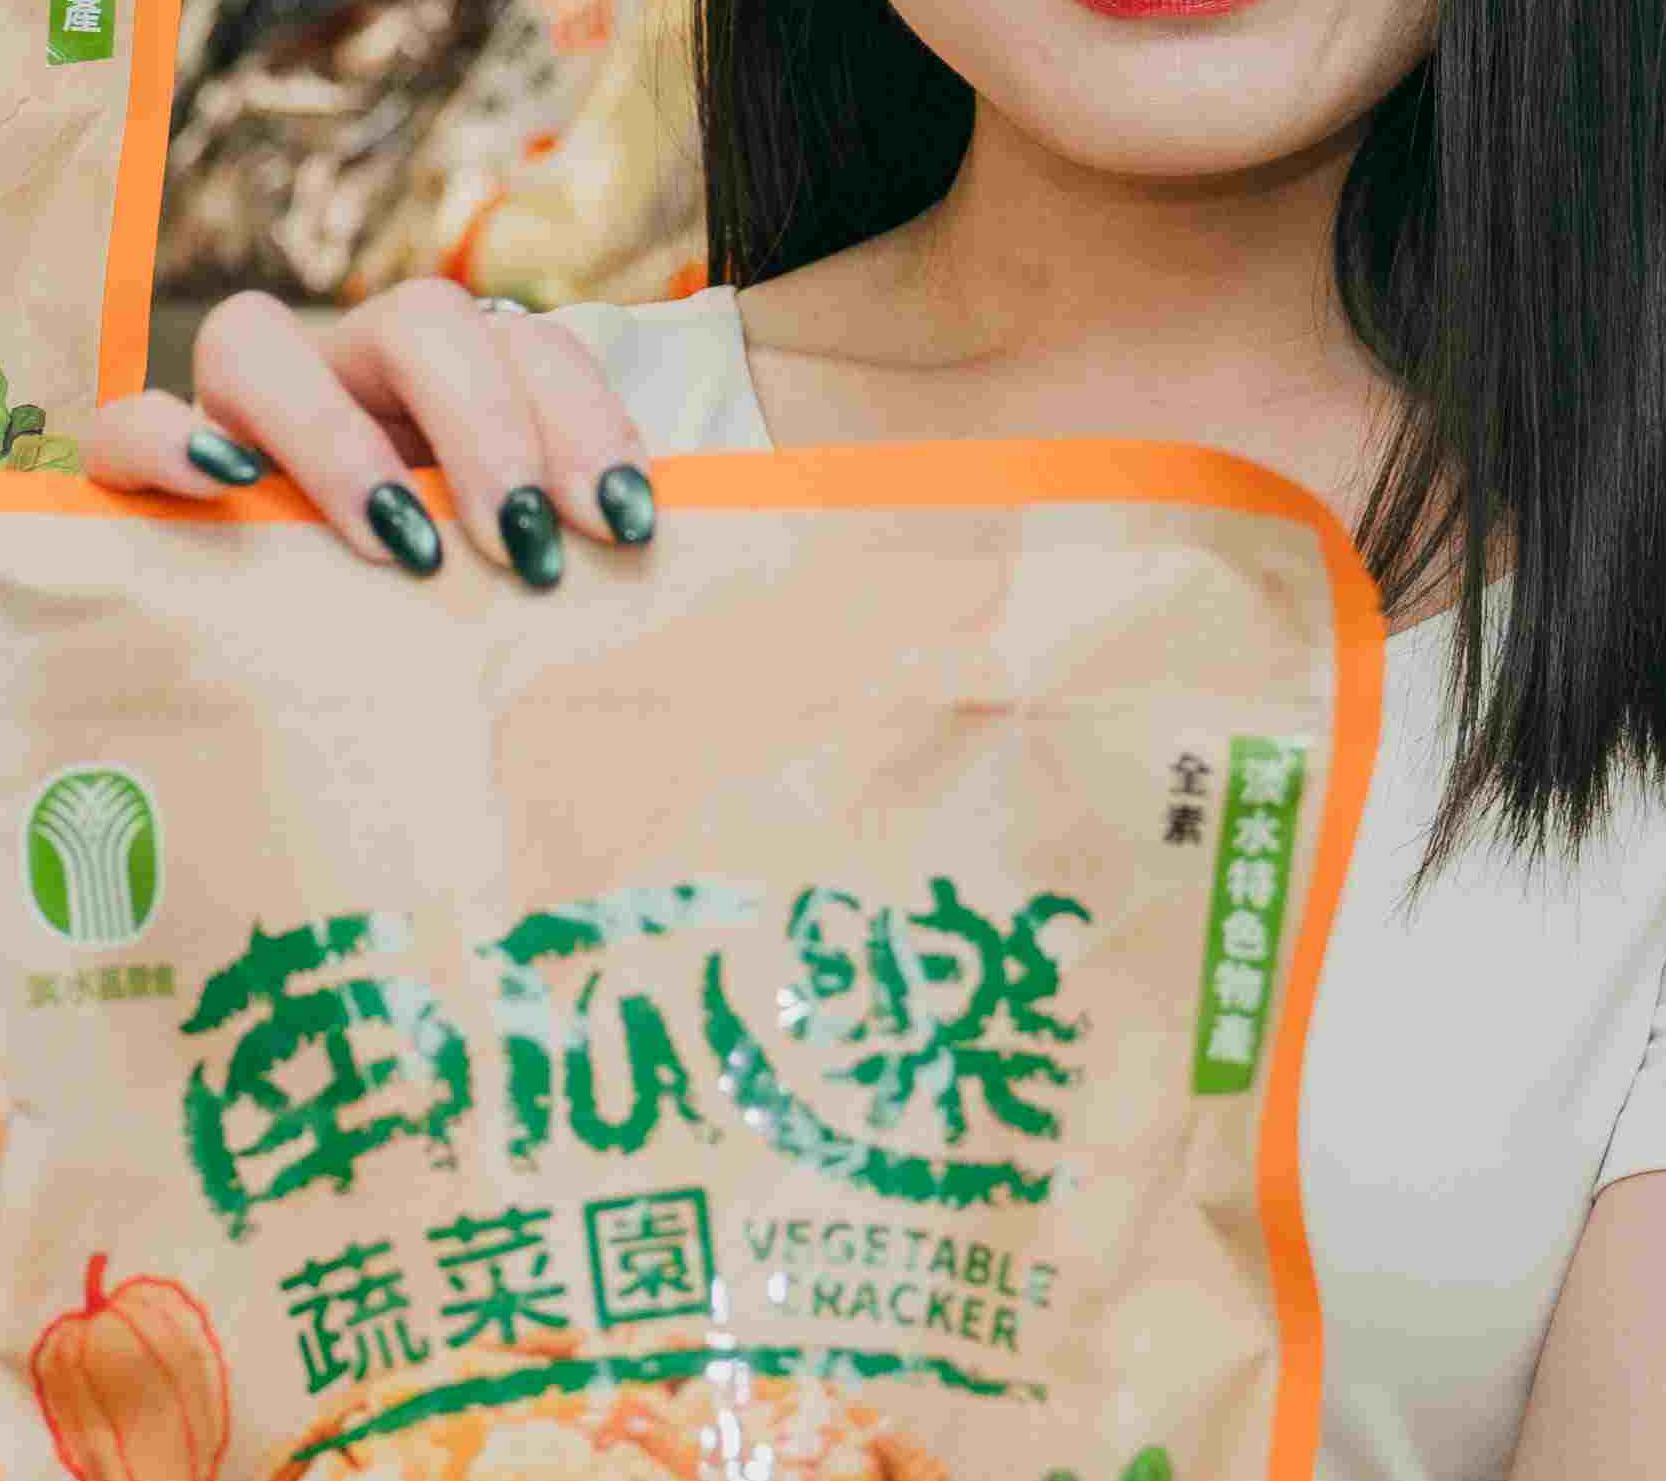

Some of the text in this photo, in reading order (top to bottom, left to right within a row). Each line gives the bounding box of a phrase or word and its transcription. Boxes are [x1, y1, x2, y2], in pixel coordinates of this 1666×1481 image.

[1164, 752, 1212, 846] 全素
[178, 874, 1094, 1242] 南瓜樂
[278, 1184, 722, 1398] 蔬菜園
[742, 1216, 1058, 1310] VEGETABLE
